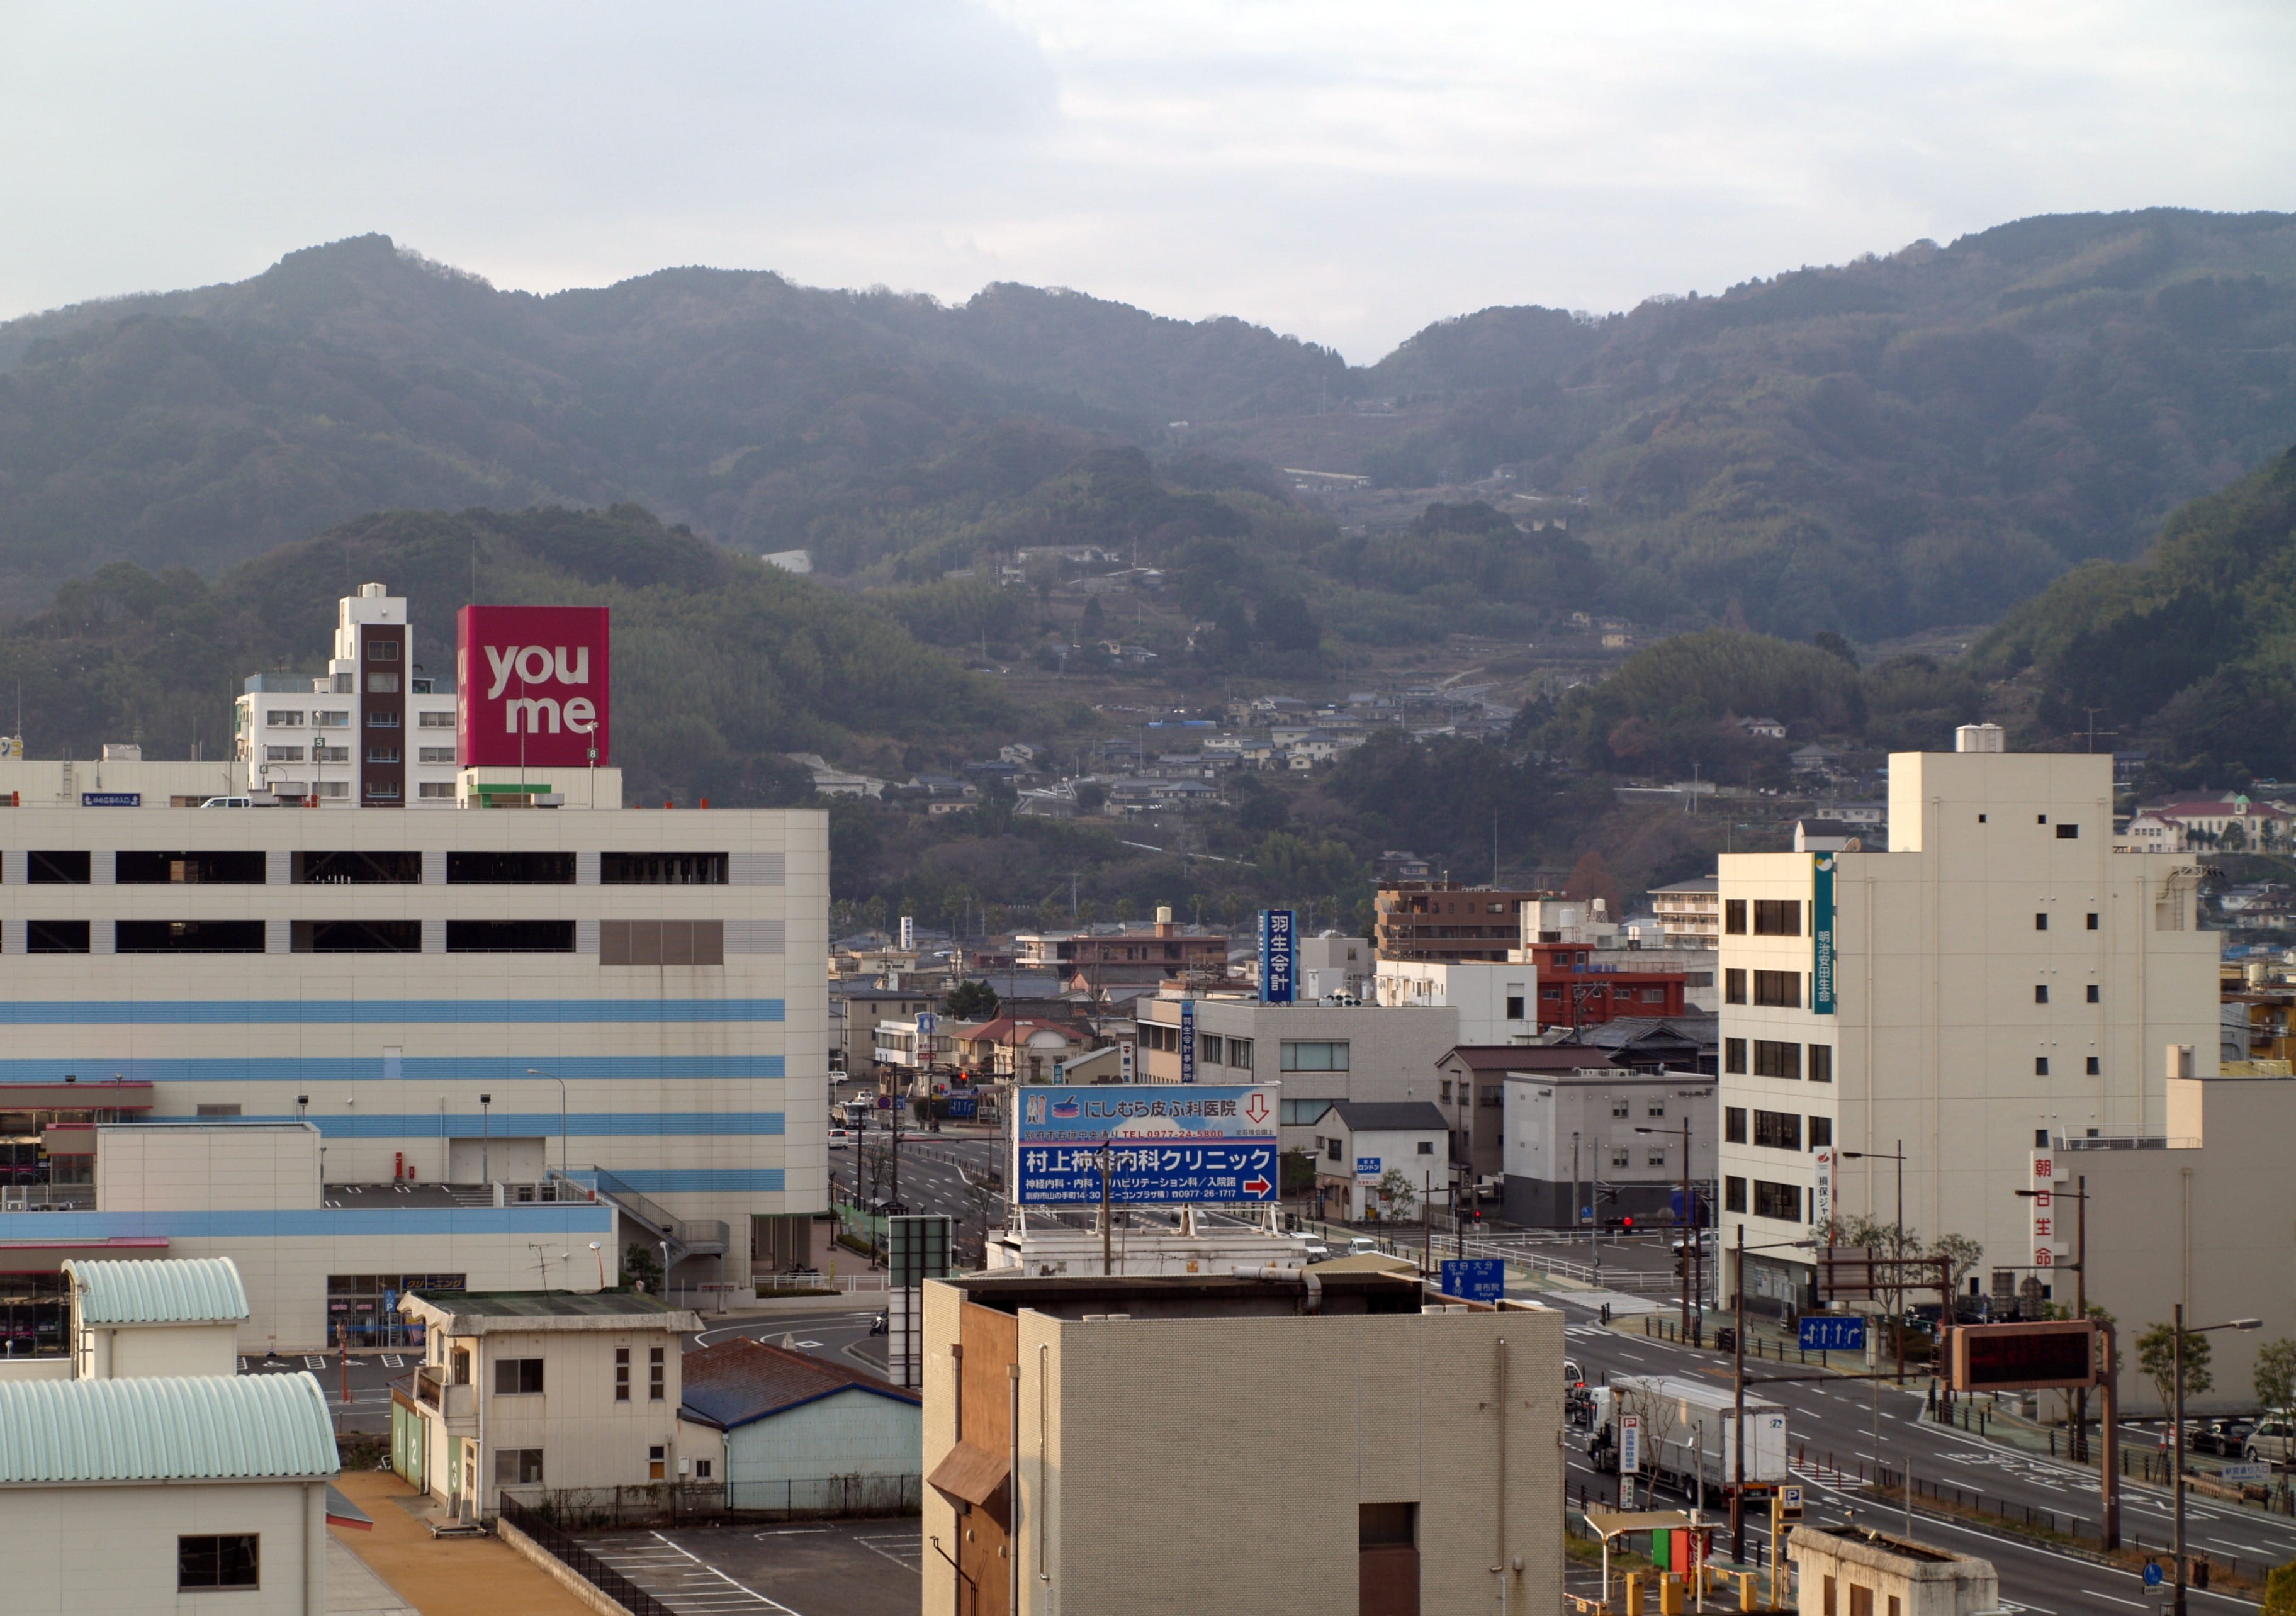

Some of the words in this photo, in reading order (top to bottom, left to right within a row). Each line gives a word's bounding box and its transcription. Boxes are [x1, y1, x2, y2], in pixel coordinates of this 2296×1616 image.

[484, 645, 589, 700] you
[506, 697, 596, 734] me
[317, 738, 323, 747] 5
[589, 749, 595, 758] 8
[1270, 915, 1289, 992] 羽生会計
[1818, 931, 1830, 1002] 明治安田生命
[1183, 1016, 1192, 1081] 羽生会計事務所
[1084, 1100, 1237, 1118] にしむら皮ふ科医院
[1025, 1131, 1118, 1140] 別府市石垣中央通り
[1123, 1130, 1144, 1138] TEL
[1147, 1130, 1224, 1138] 0977-24-5800
[2035, 1159, 2052, 1267] 朝日生命
[386, 1303, 393, 1311] P
[1625, 1418, 1635, 1427] P
[411, 1438, 417, 1466] 2
[452, 1460, 458, 1488] 3
[1788, 1490, 1798, 1500] P
